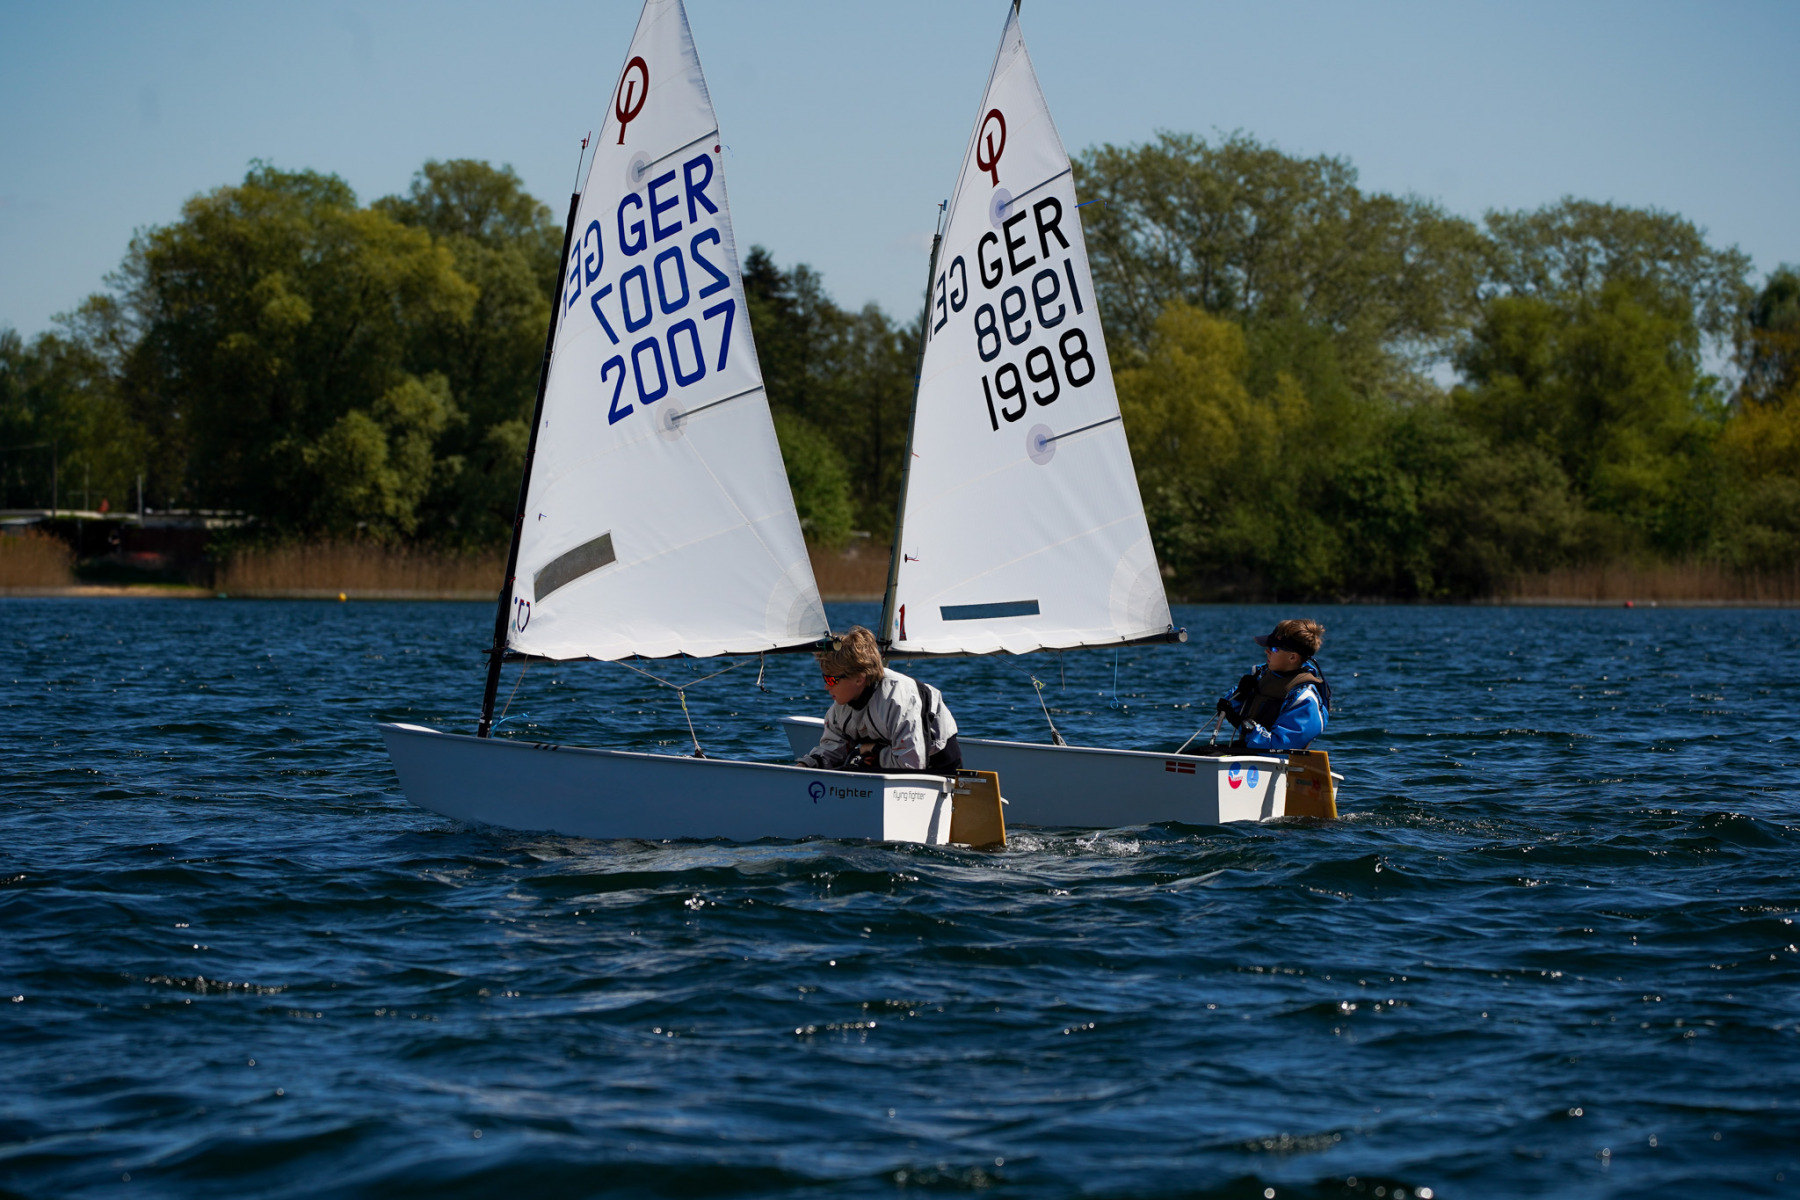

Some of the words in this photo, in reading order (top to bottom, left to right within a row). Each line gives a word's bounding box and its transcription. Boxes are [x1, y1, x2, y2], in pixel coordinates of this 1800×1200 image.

[617, 153, 719, 257] GER
[977, 196, 1070, 290] GER
[600, 298, 736, 426] 2007
[981, 327, 1096, 432] 1998
[829, 785, 873, 799] fighter
[892, 789, 908, 801] flying
[908, 790, 926, 801] fighter
